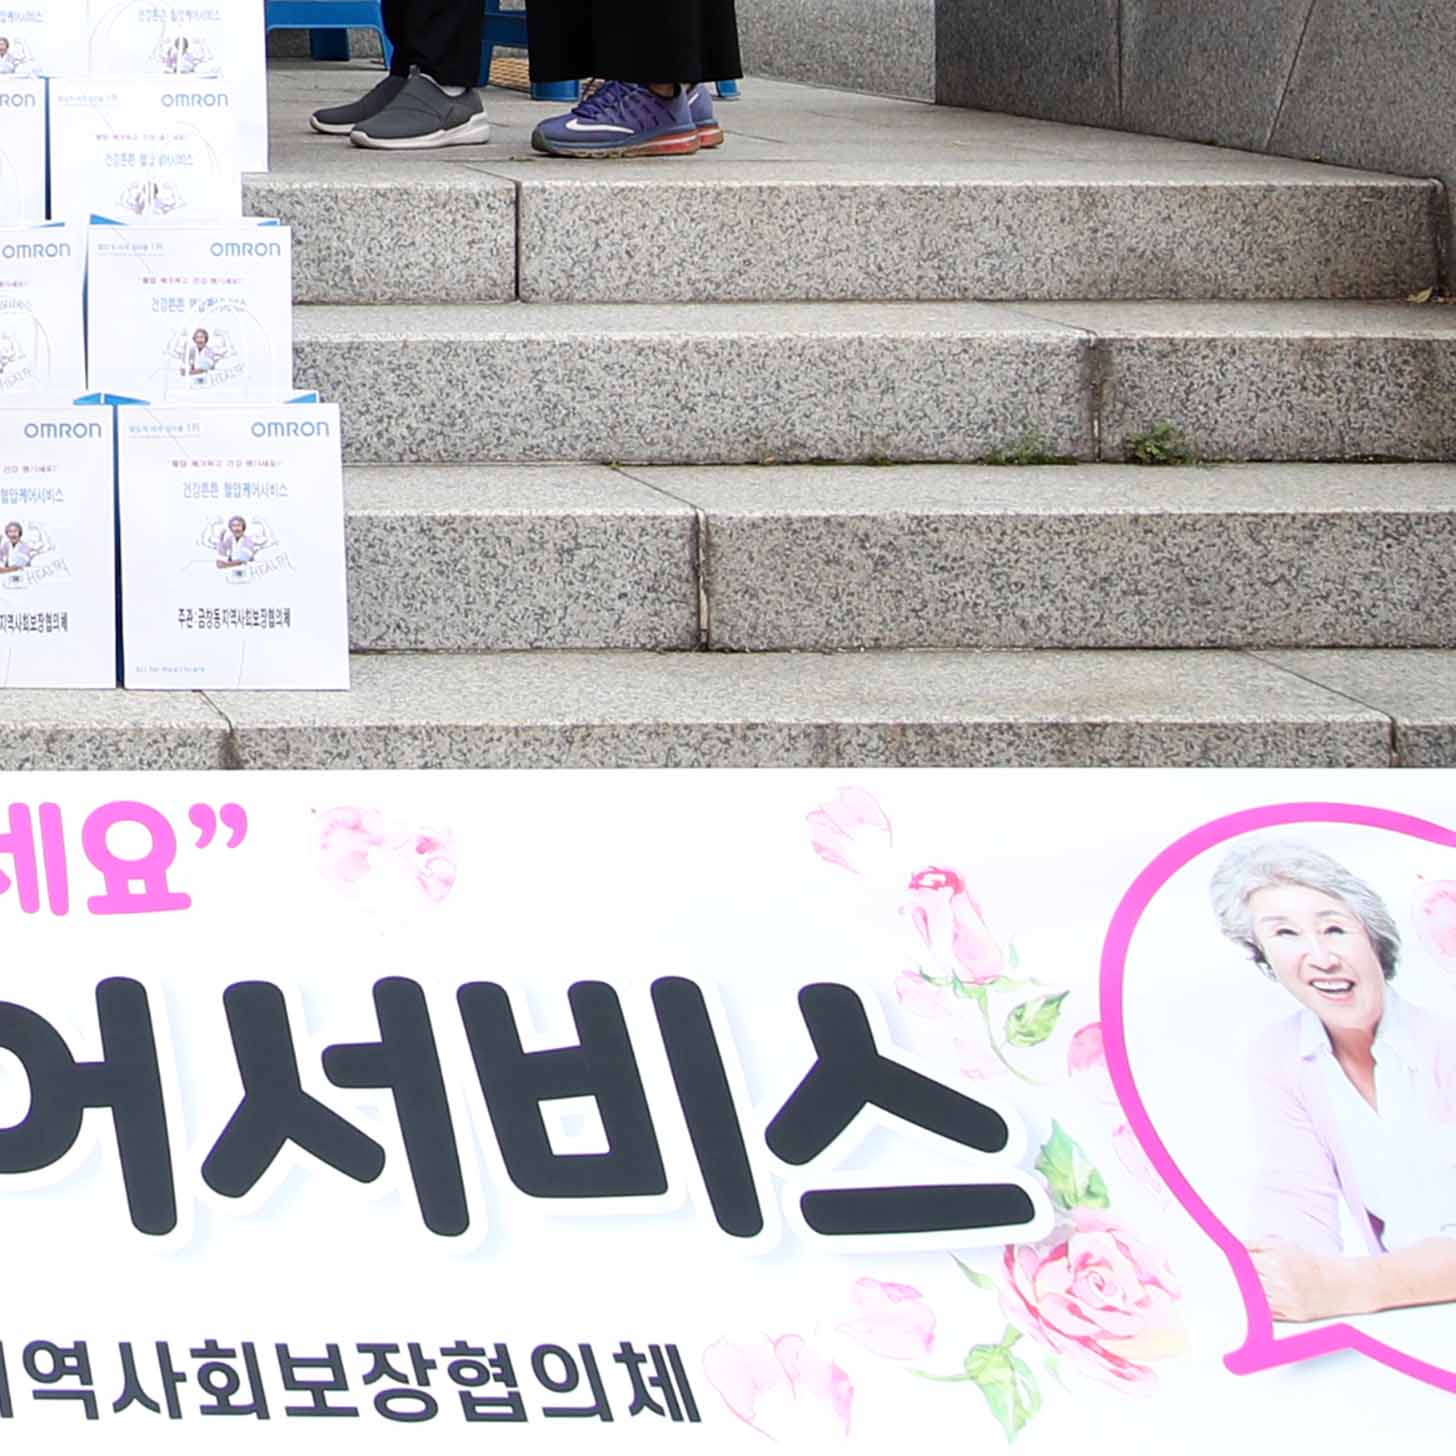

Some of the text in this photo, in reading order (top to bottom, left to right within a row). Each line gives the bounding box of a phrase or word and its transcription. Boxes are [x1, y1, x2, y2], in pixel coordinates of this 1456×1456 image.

[161, 93, 228, 107] OMRON
[2, 243, 71, 259] OMRON
[210, 242, 280, 256] OMRON
[24, 423, 101, 438] OMRON
[251, 421, 330, 437] OMRON
